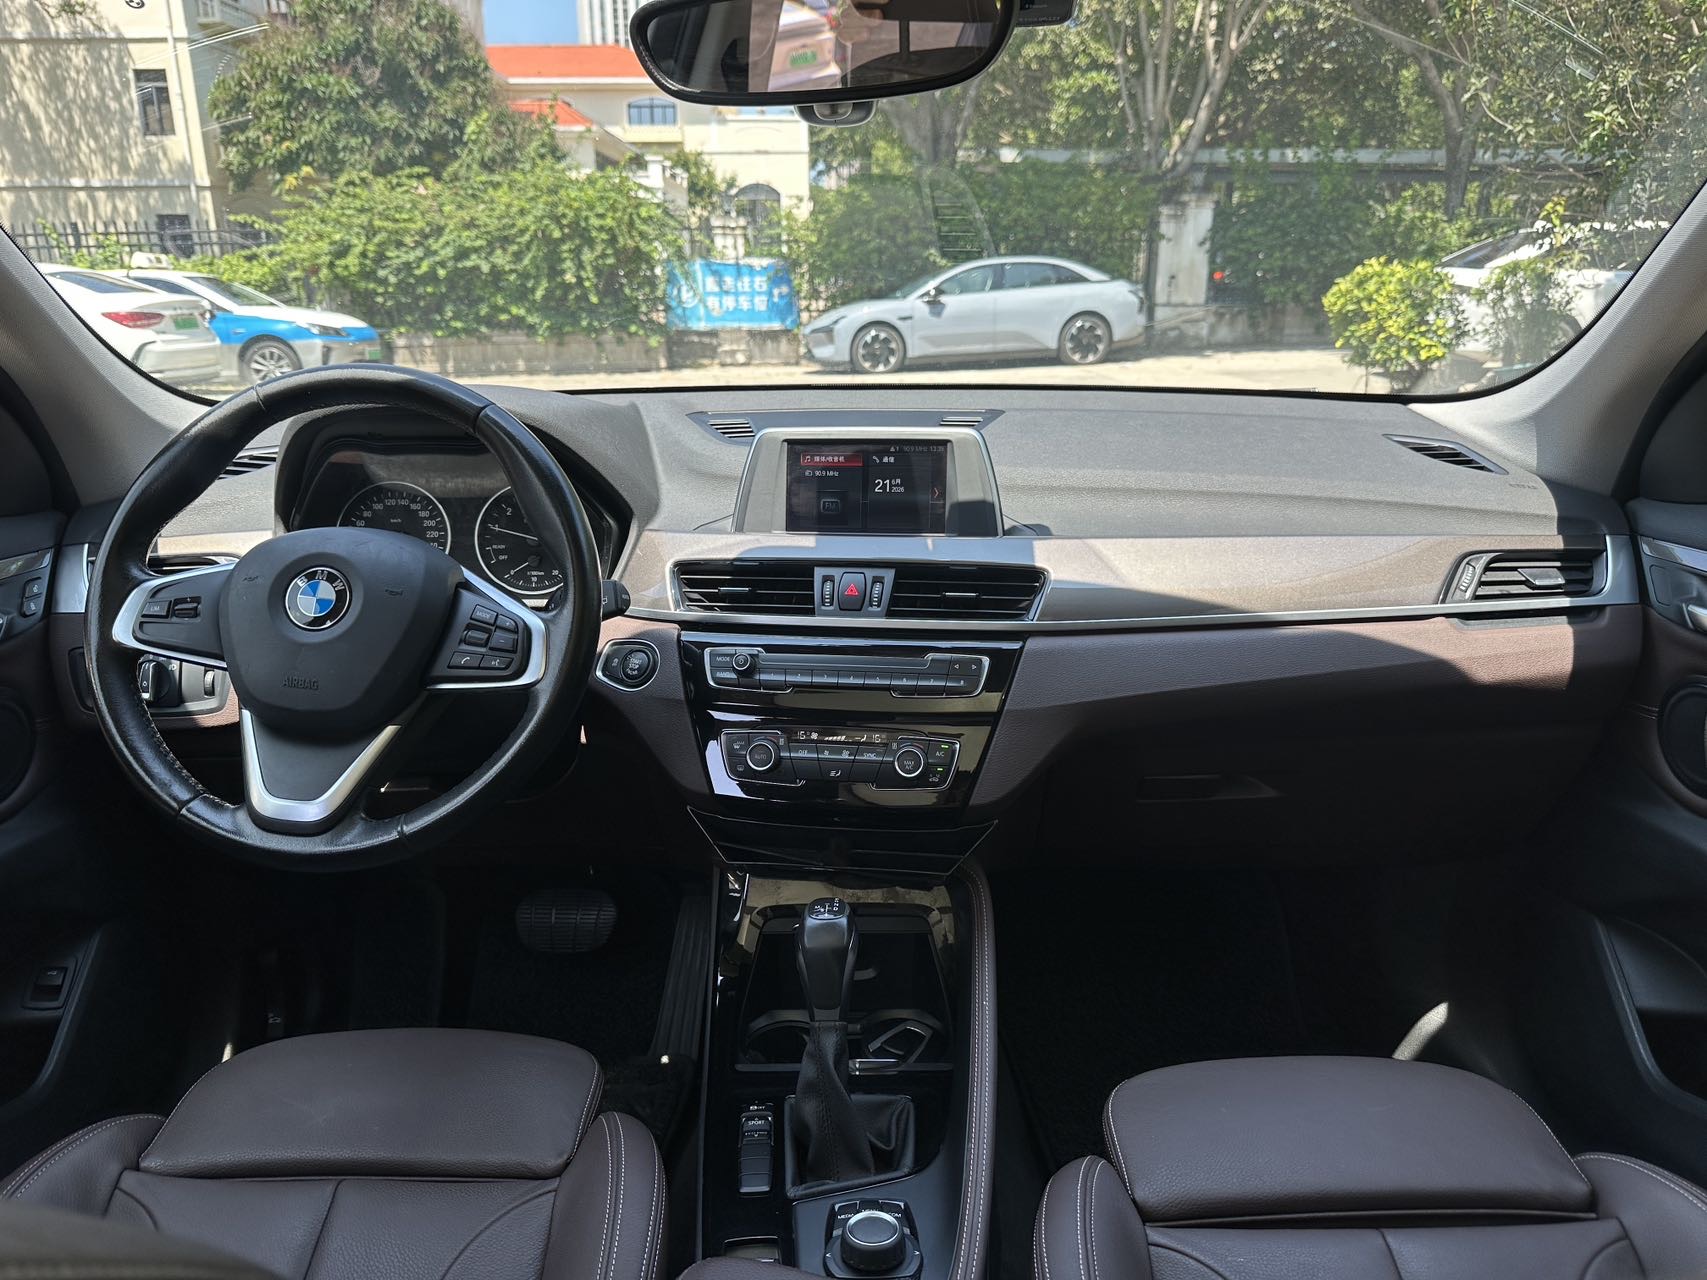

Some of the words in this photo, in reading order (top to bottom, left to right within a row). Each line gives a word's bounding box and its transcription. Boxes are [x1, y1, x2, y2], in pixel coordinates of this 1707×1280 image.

[874, 479, 890, 493] 21
[506, 507, 512, 516] 2
[297, 570, 345, 591] BMW
[476, 610, 491, 619] MODE
[281, 676, 319, 691] AIRBAG
